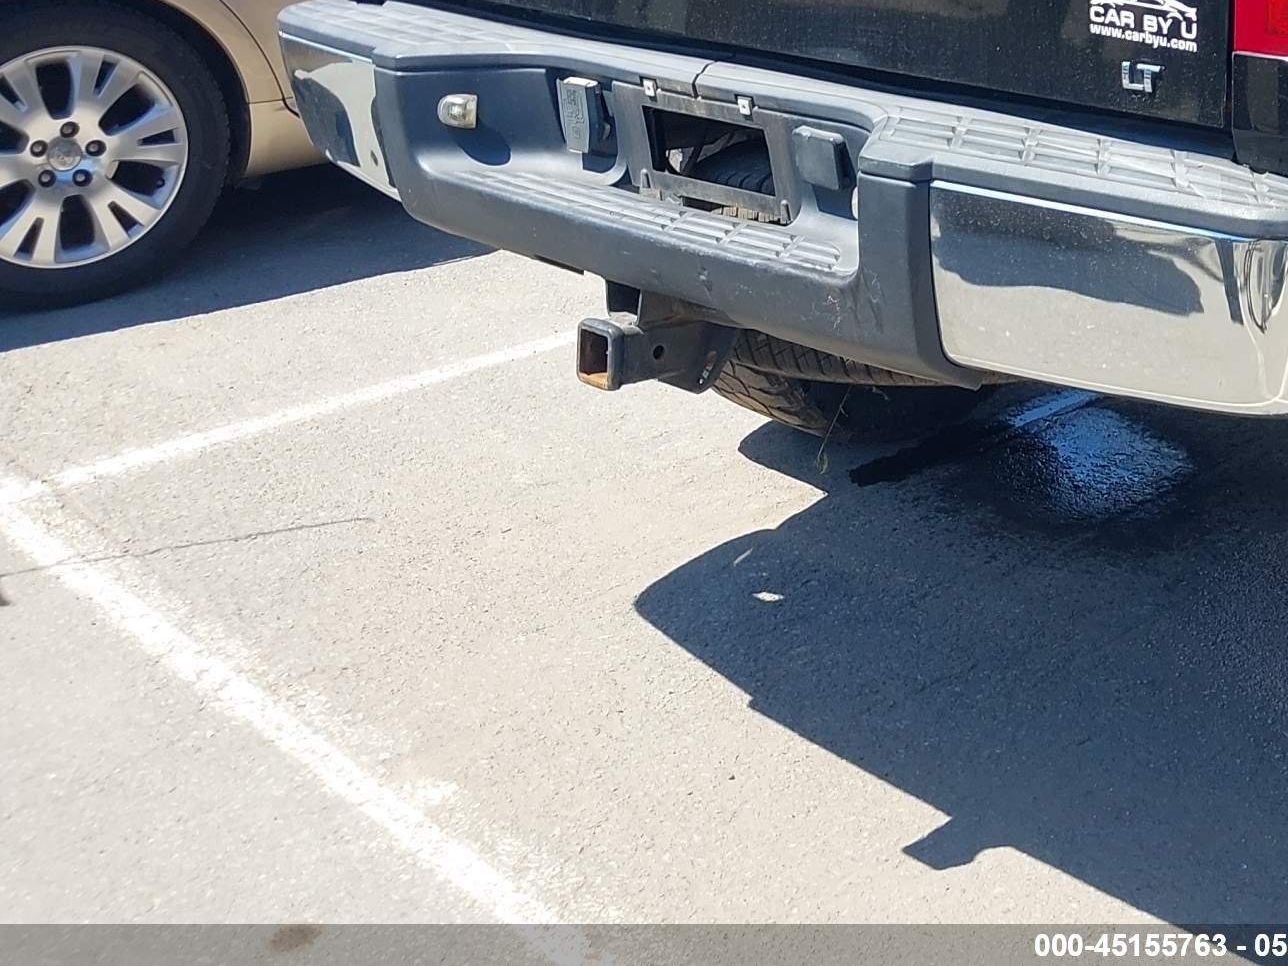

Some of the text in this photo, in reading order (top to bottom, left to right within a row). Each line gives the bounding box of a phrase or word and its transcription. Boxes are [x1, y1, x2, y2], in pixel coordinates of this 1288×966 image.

[1089, 5, 1197, 39] CAR BY U
[1089, 23, 1198, 53] www.carbyu.com
[1121, 61, 1162, 93] LT
